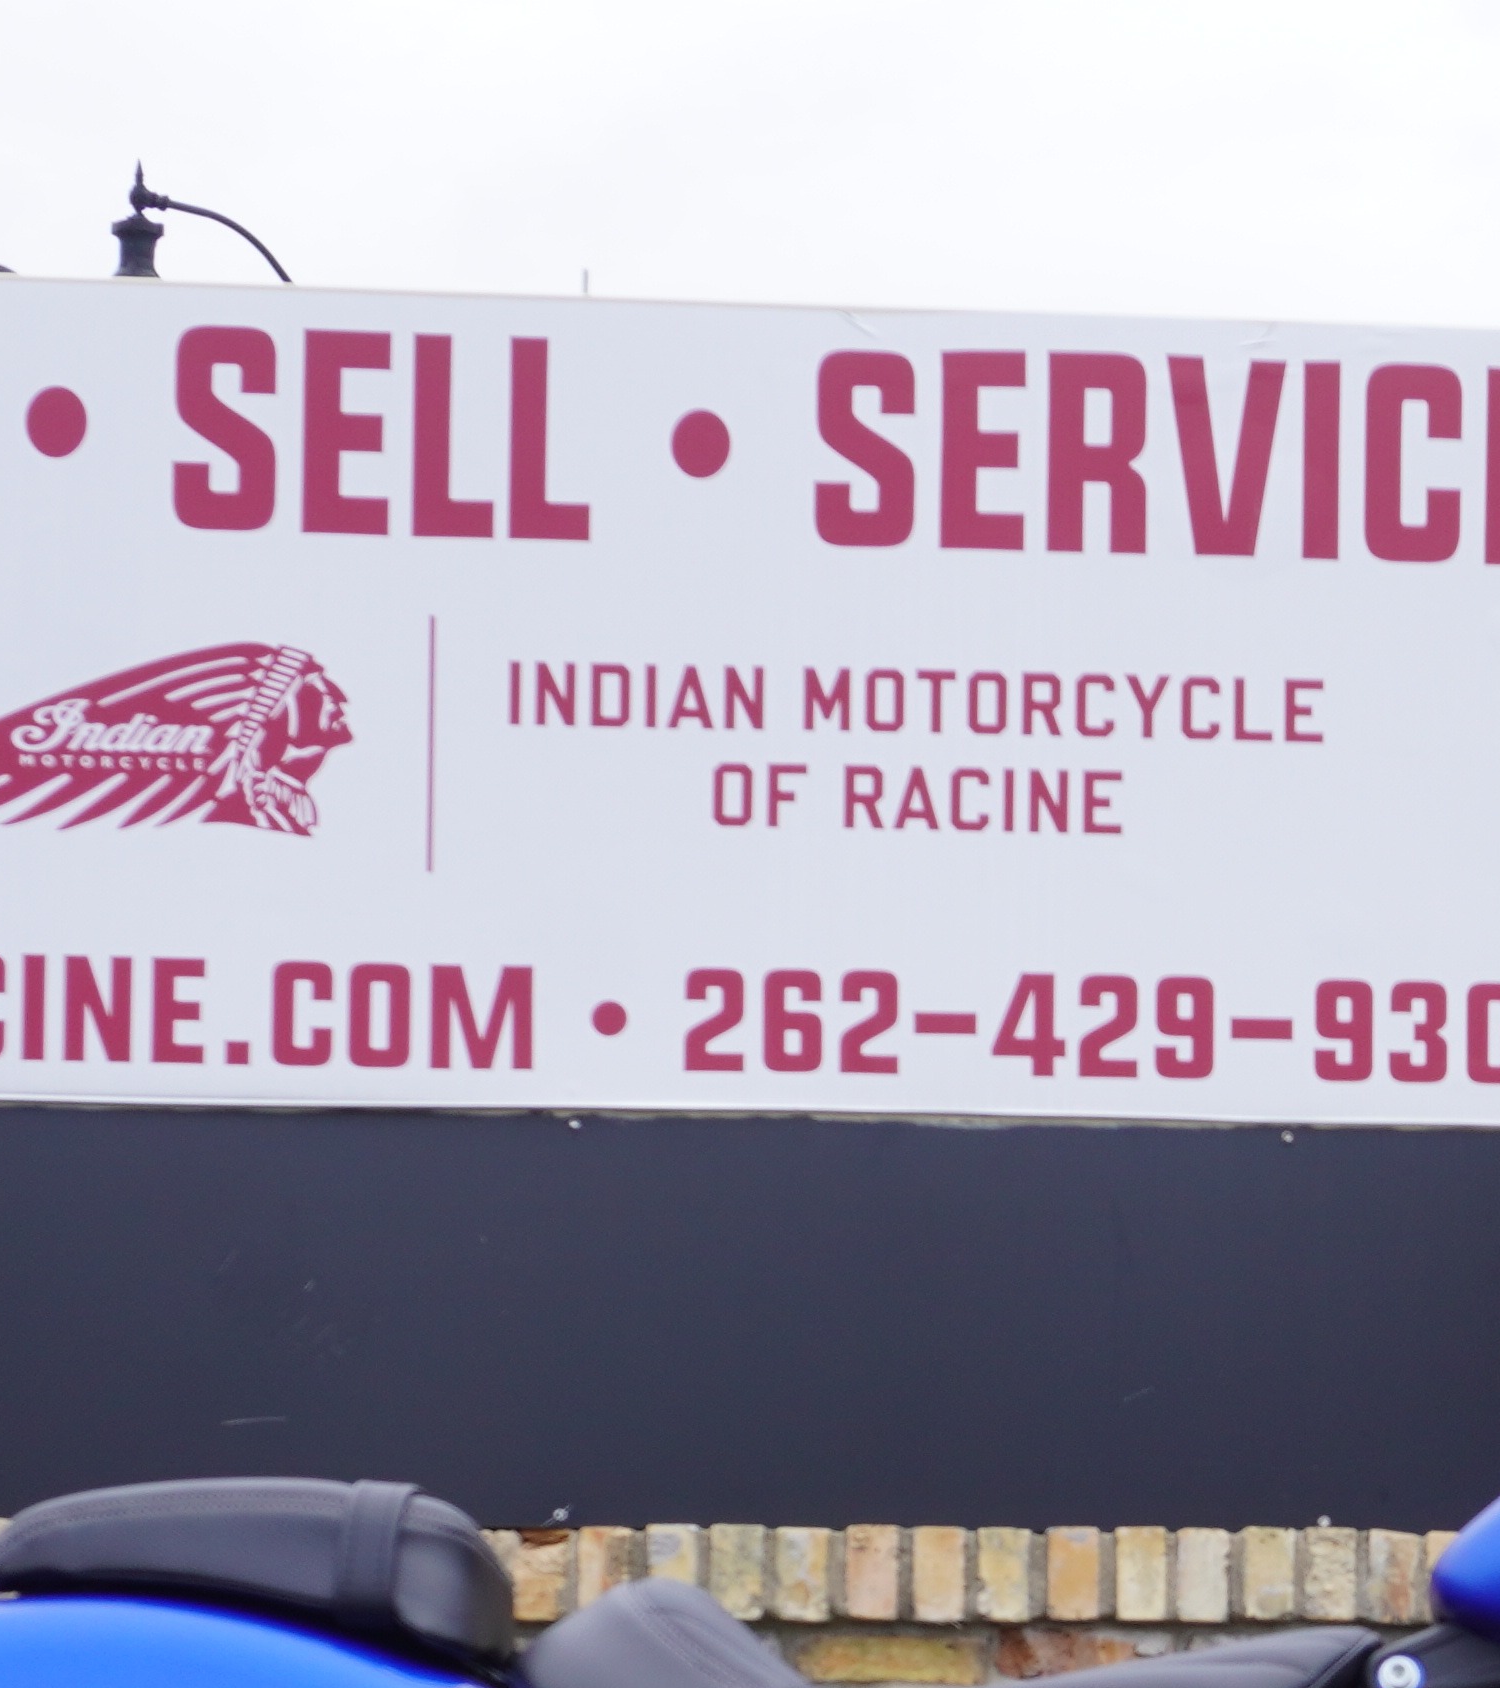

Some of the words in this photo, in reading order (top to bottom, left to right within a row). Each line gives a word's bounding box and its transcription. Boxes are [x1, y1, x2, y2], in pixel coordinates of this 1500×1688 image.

[172, 325, 591, 542] SELL
[10, 698, 214, 754] Indian
[509, 662, 765, 730] INDIAN
[802, 668, 1324, 744] MOTORCYCLE
[18, 753, 206, 772] MOTORCYCLE
[712, 763, 808, 828] OF
[843, 765, 1123, 835] RACINE
